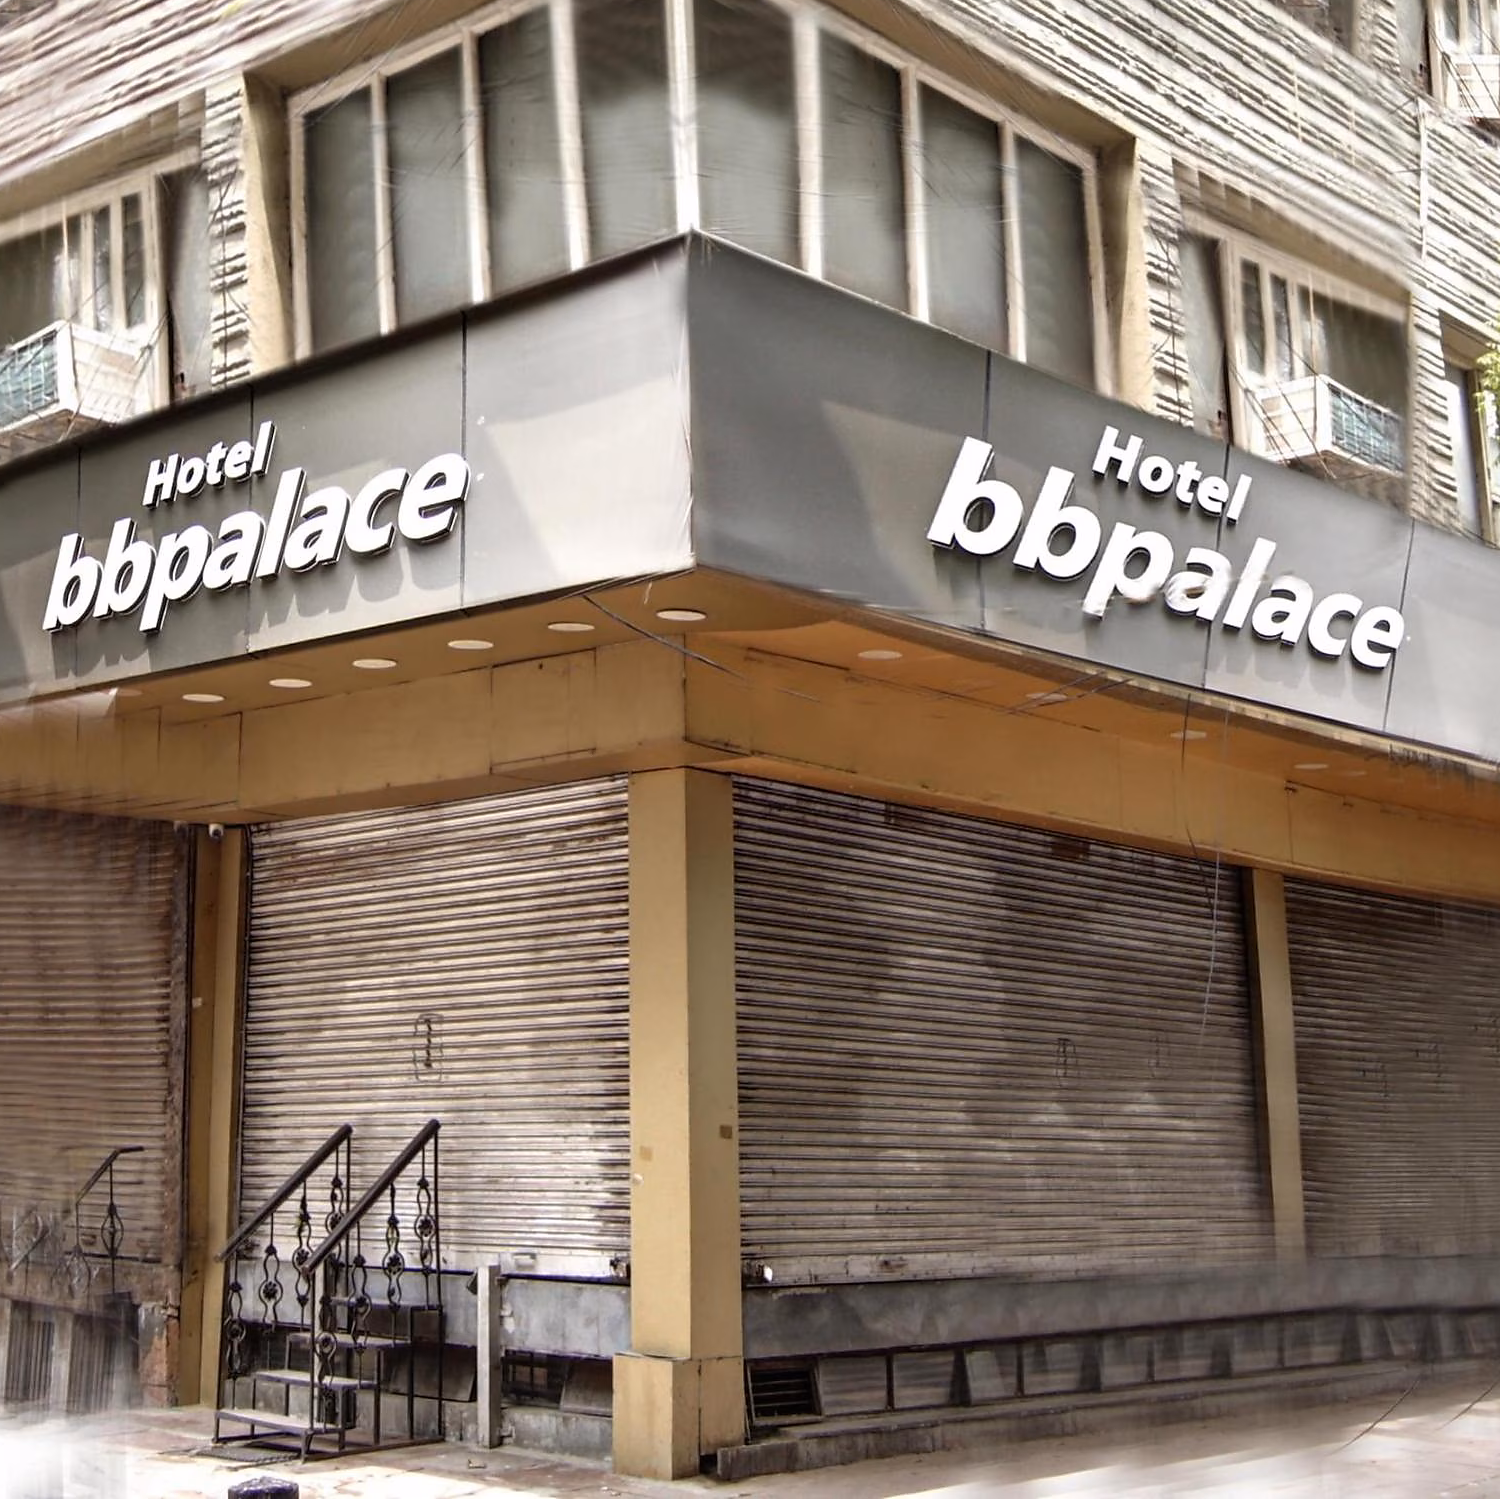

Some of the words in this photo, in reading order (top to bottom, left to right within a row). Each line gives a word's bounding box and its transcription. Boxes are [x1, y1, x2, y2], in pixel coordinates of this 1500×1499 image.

[142, 420, 277, 510] Hotel
[1092, 425, 1252, 524] Hotel
[42, 453, 470, 635] bbpalace
[926, 436, 1406, 668] bbpalace
